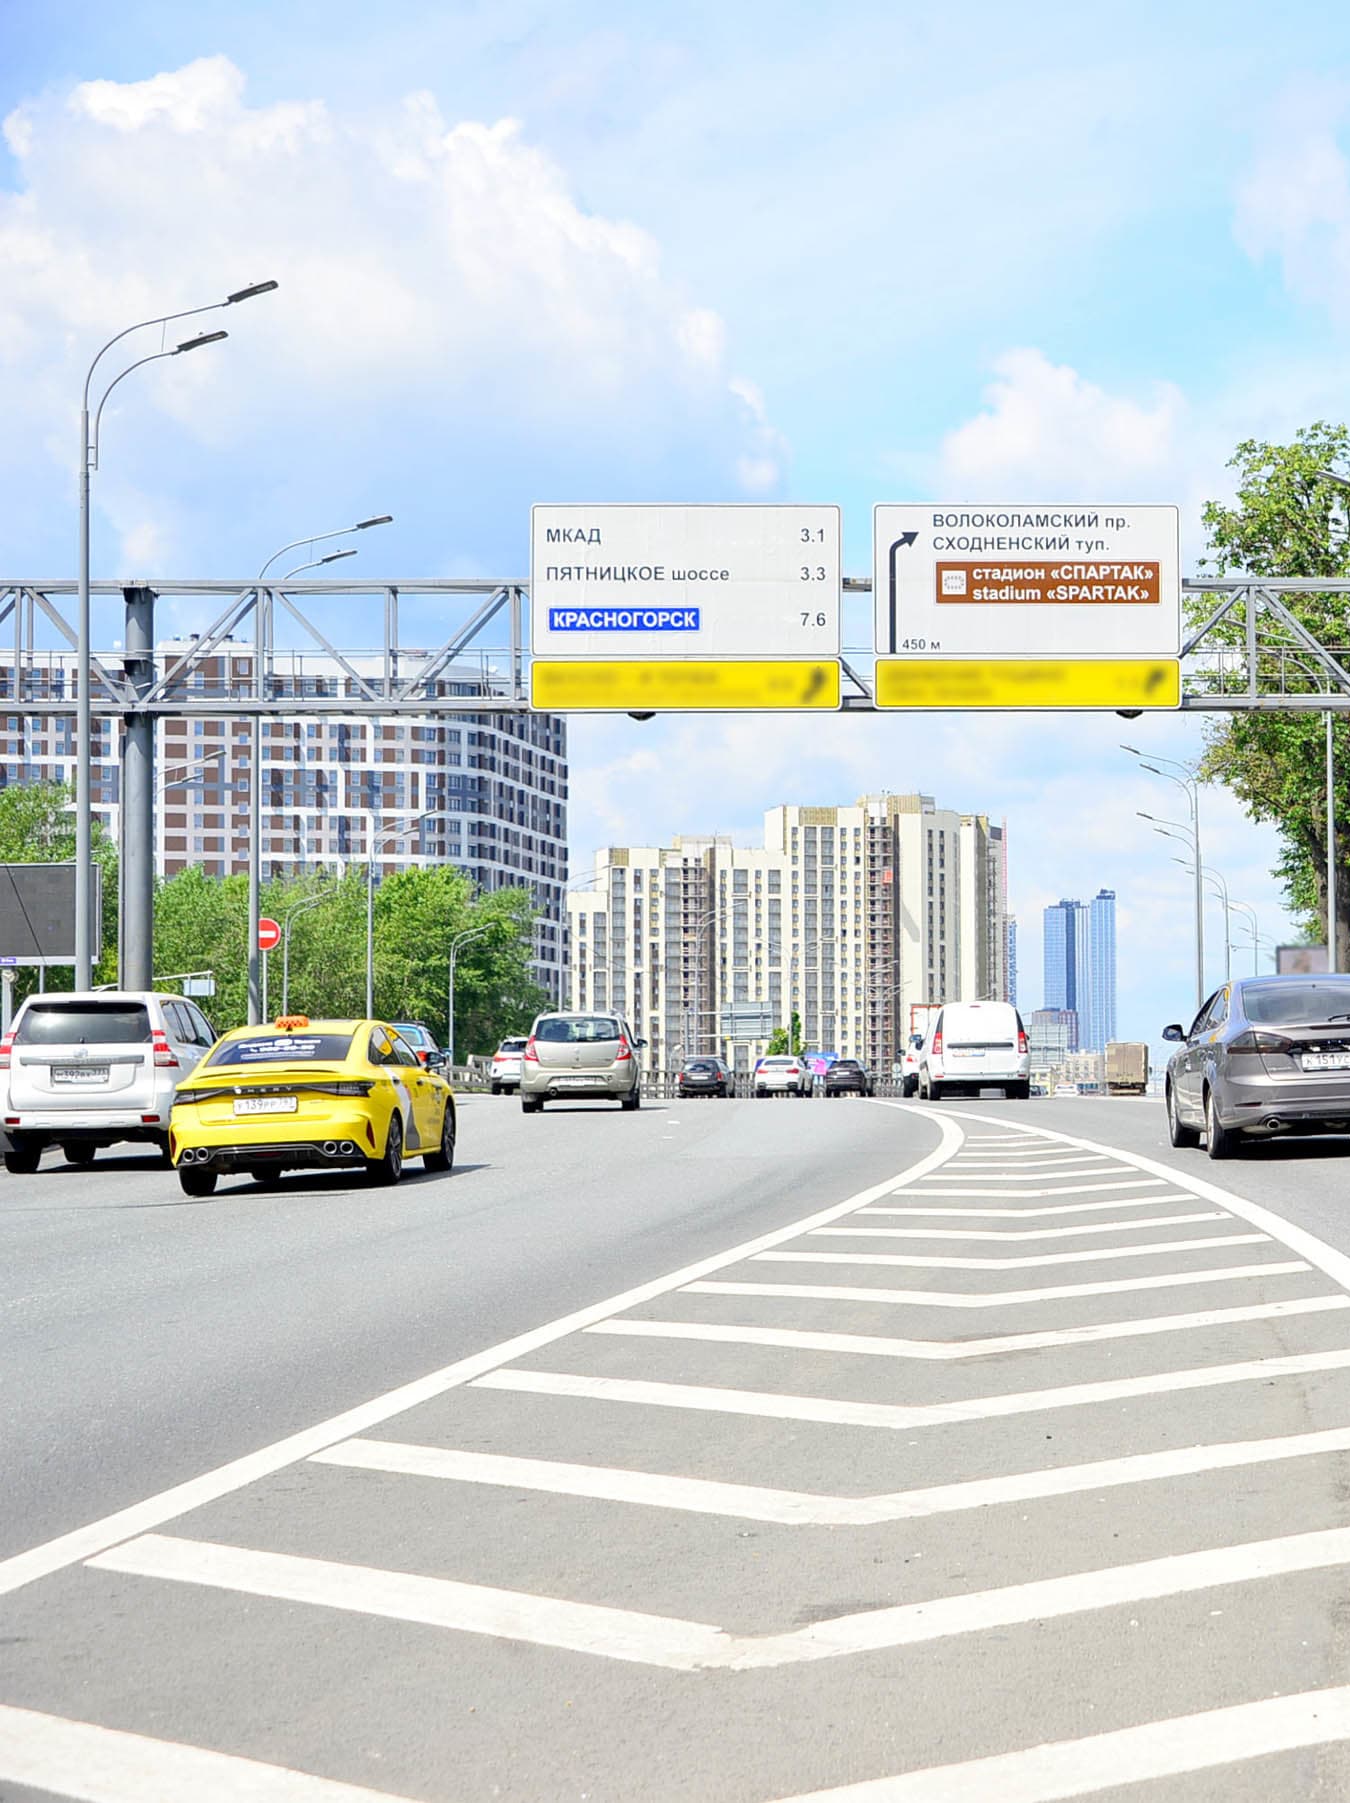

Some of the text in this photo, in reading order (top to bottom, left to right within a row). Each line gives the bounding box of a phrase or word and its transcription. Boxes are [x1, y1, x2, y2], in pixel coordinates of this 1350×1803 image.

[932, 511, 1131, 532] ВОЛОКОЛАМСКИЙ пр.
[546, 527, 824, 545] МКАД 3.1
[932, 534, 1110, 555] СХОДНЕНСКИЙ туп.
[546, 566, 826, 583] ПЯТНИЦКОЕ шоссе 3.3
[972, 564, 1154, 582] стадион «СПАРТАК»
[972, 585, 1150, 601] stadium «SPARTAK»
[553, 611, 826, 628] КРАСНОГОРСК 7.6
[902, 638, 941, 651] 450 м
